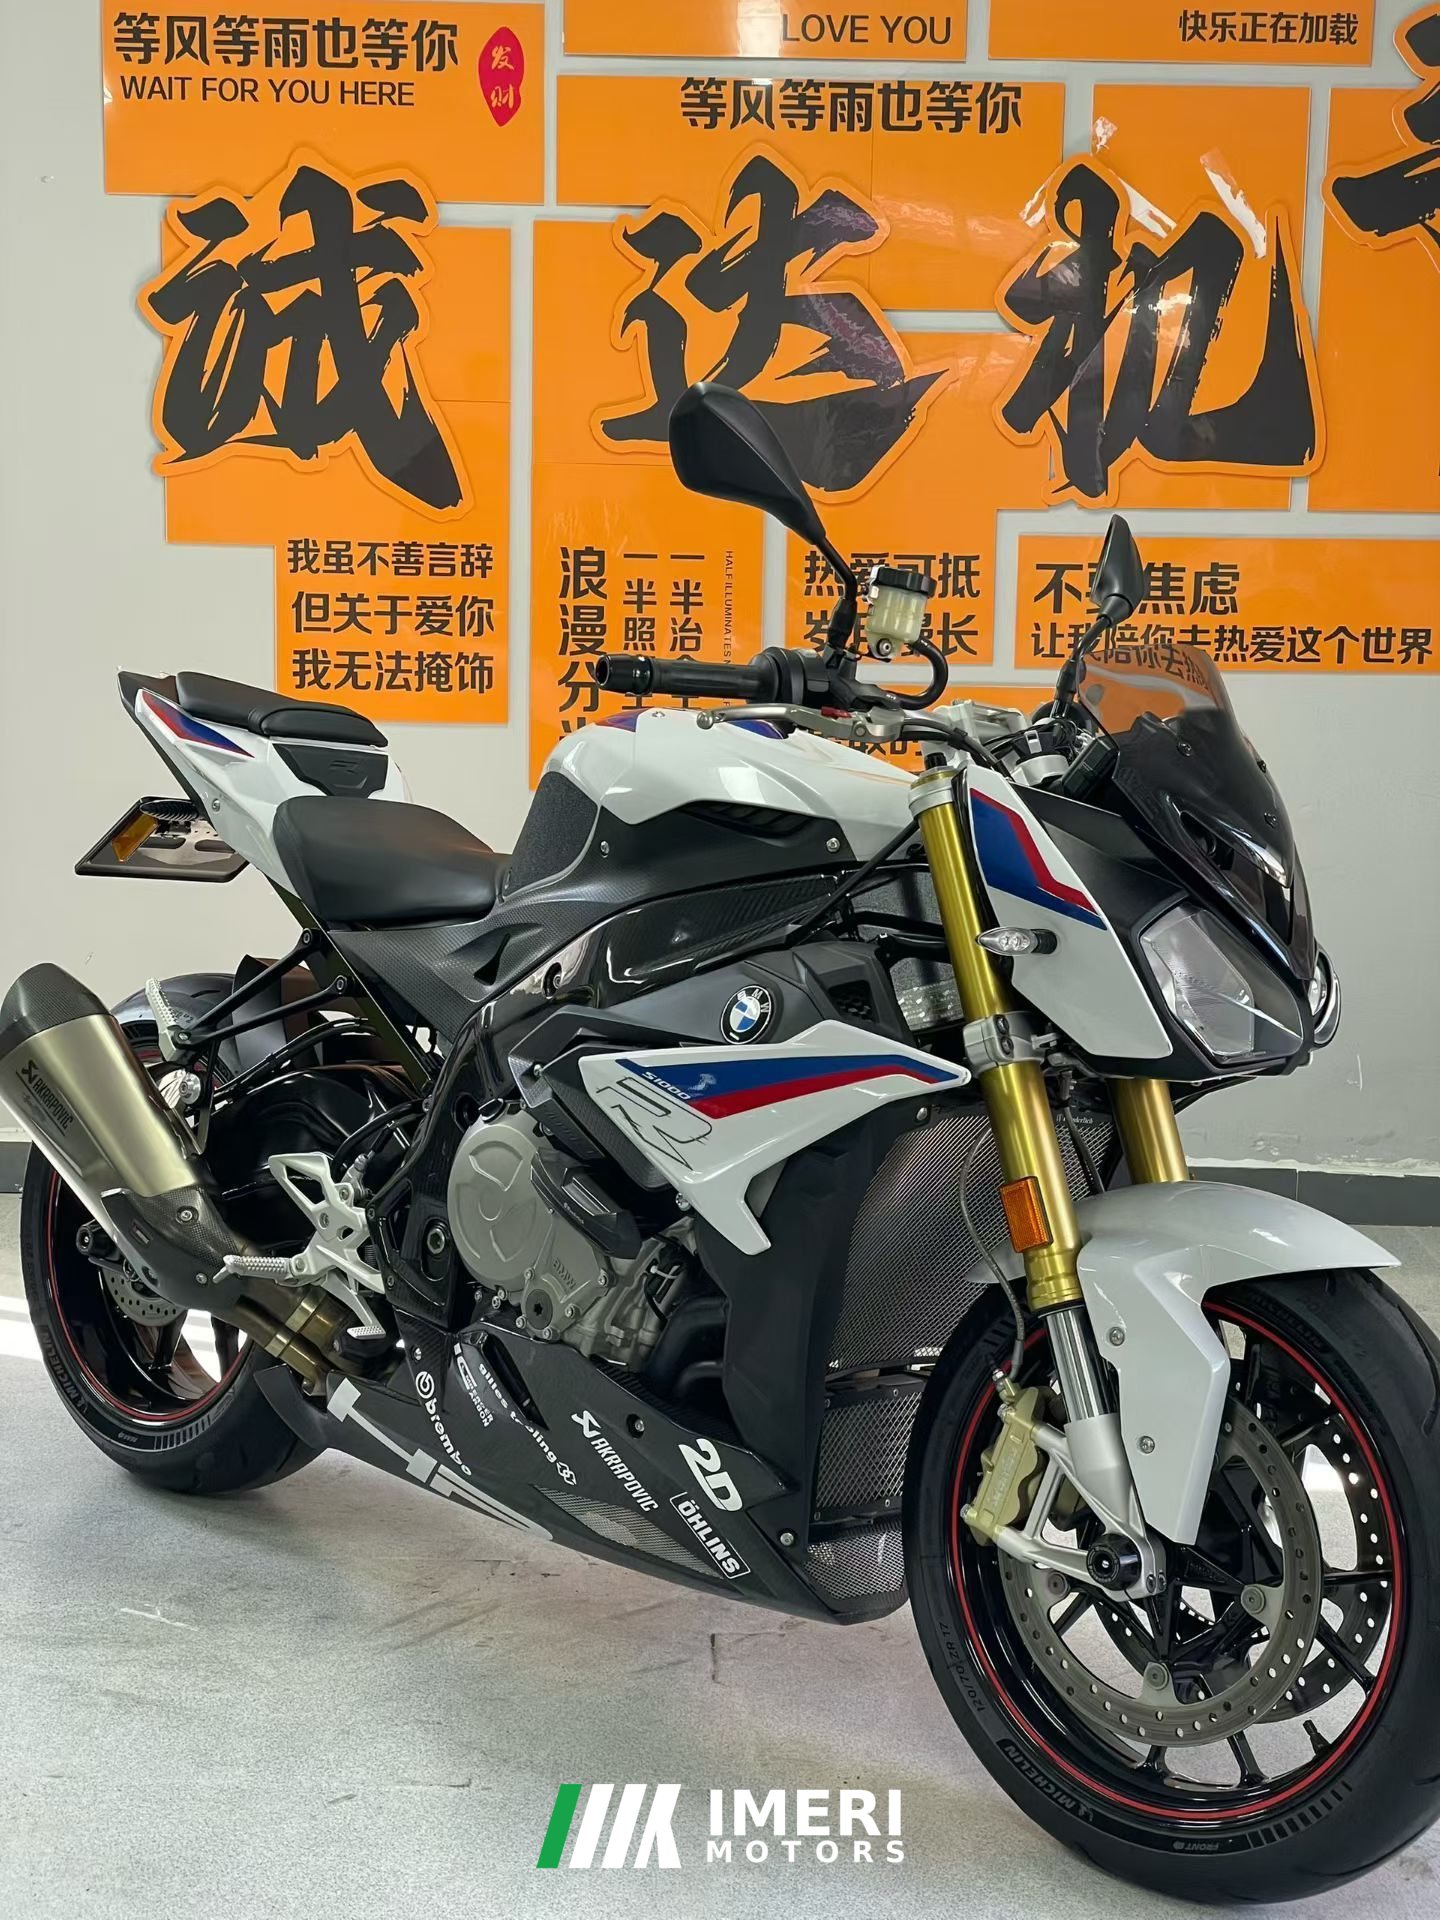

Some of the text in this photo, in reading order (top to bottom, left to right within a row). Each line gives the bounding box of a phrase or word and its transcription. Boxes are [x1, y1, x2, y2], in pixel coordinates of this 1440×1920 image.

[114, 12, 458, 72] 等风等雨也等你
[783, 14, 951, 45] LOVE YOU
[1179, 9, 1358, 46] 快乐正在加载
[121, 76, 415, 106] WAIT FOR YOU HERE
[681, 77, 1022, 134] 等风等雨也等你
[287, 538, 494, 578] 我虽不善言辞
[724, 550, 733, 579] HALF
[1034, 562, 1240, 615] 不焦虑
[291, 591, 494, 638] 但关于爱你
[292, 648, 494, 694] 我无法掩饰
[424, 1397, 473, 1476] brembo
[678, 1438, 743, 1512] 2D
[677, 1499, 741, 1574] ÖHLINS
[1003, 1744, 1077, 1811] MICHELIN
